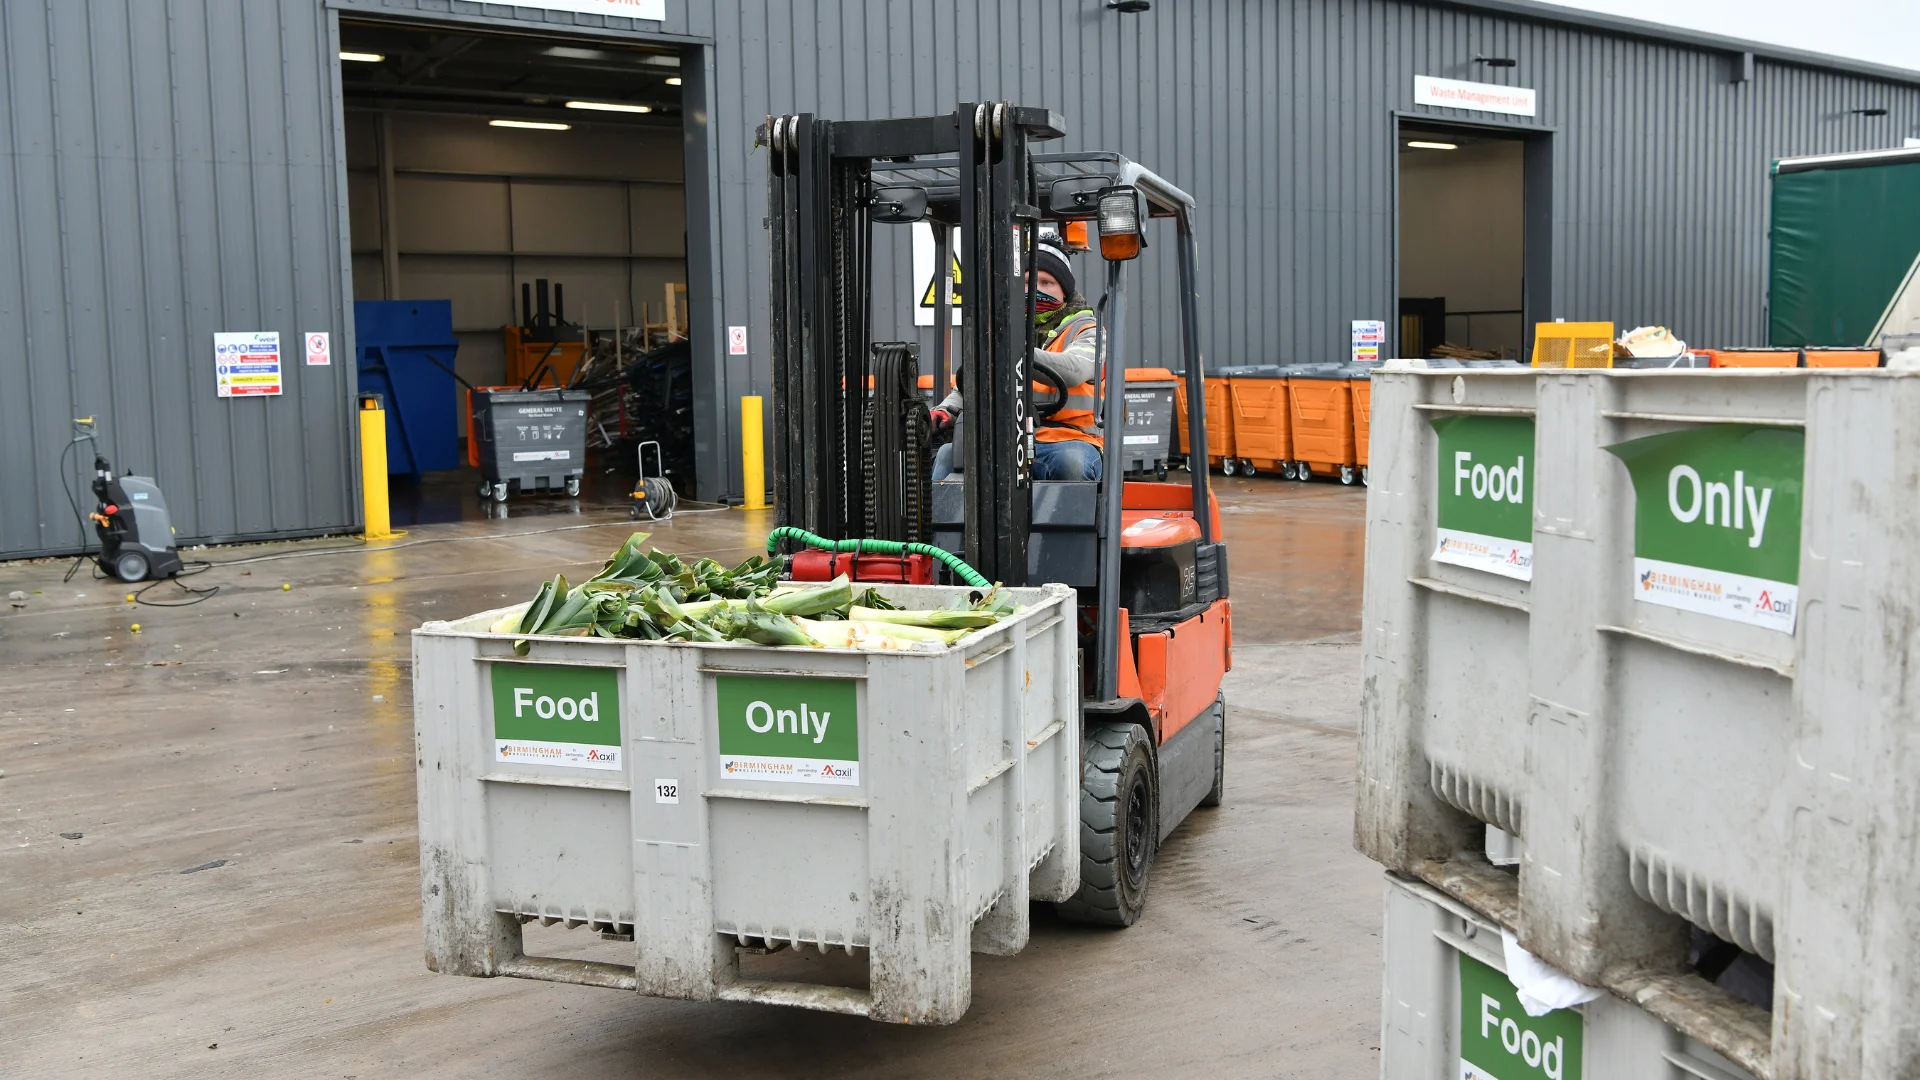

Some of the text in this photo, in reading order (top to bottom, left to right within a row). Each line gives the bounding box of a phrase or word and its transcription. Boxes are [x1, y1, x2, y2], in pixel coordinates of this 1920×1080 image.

[1430, 85, 1528, 107] Waste Management Unit
[1015, 357, 1024, 487] TOYOTA
[1455, 451, 1524, 504] Food
[1668, 464, 1773, 549] Only
[1651, 572, 1722, 595] BIRMINGHAM
[513, 687, 599, 722] Food
[745, 700, 831, 744] Only
[508, 745, 562, 755] BIRMINGHAM
[599, 753, 615, 761] axil
[734, 761, 793, 771] BIRMINGHAM
[835, 768, 852, 777] axil
[656, 784, 677, 798] 132
[1481, 992, 1564, 1080] Food
